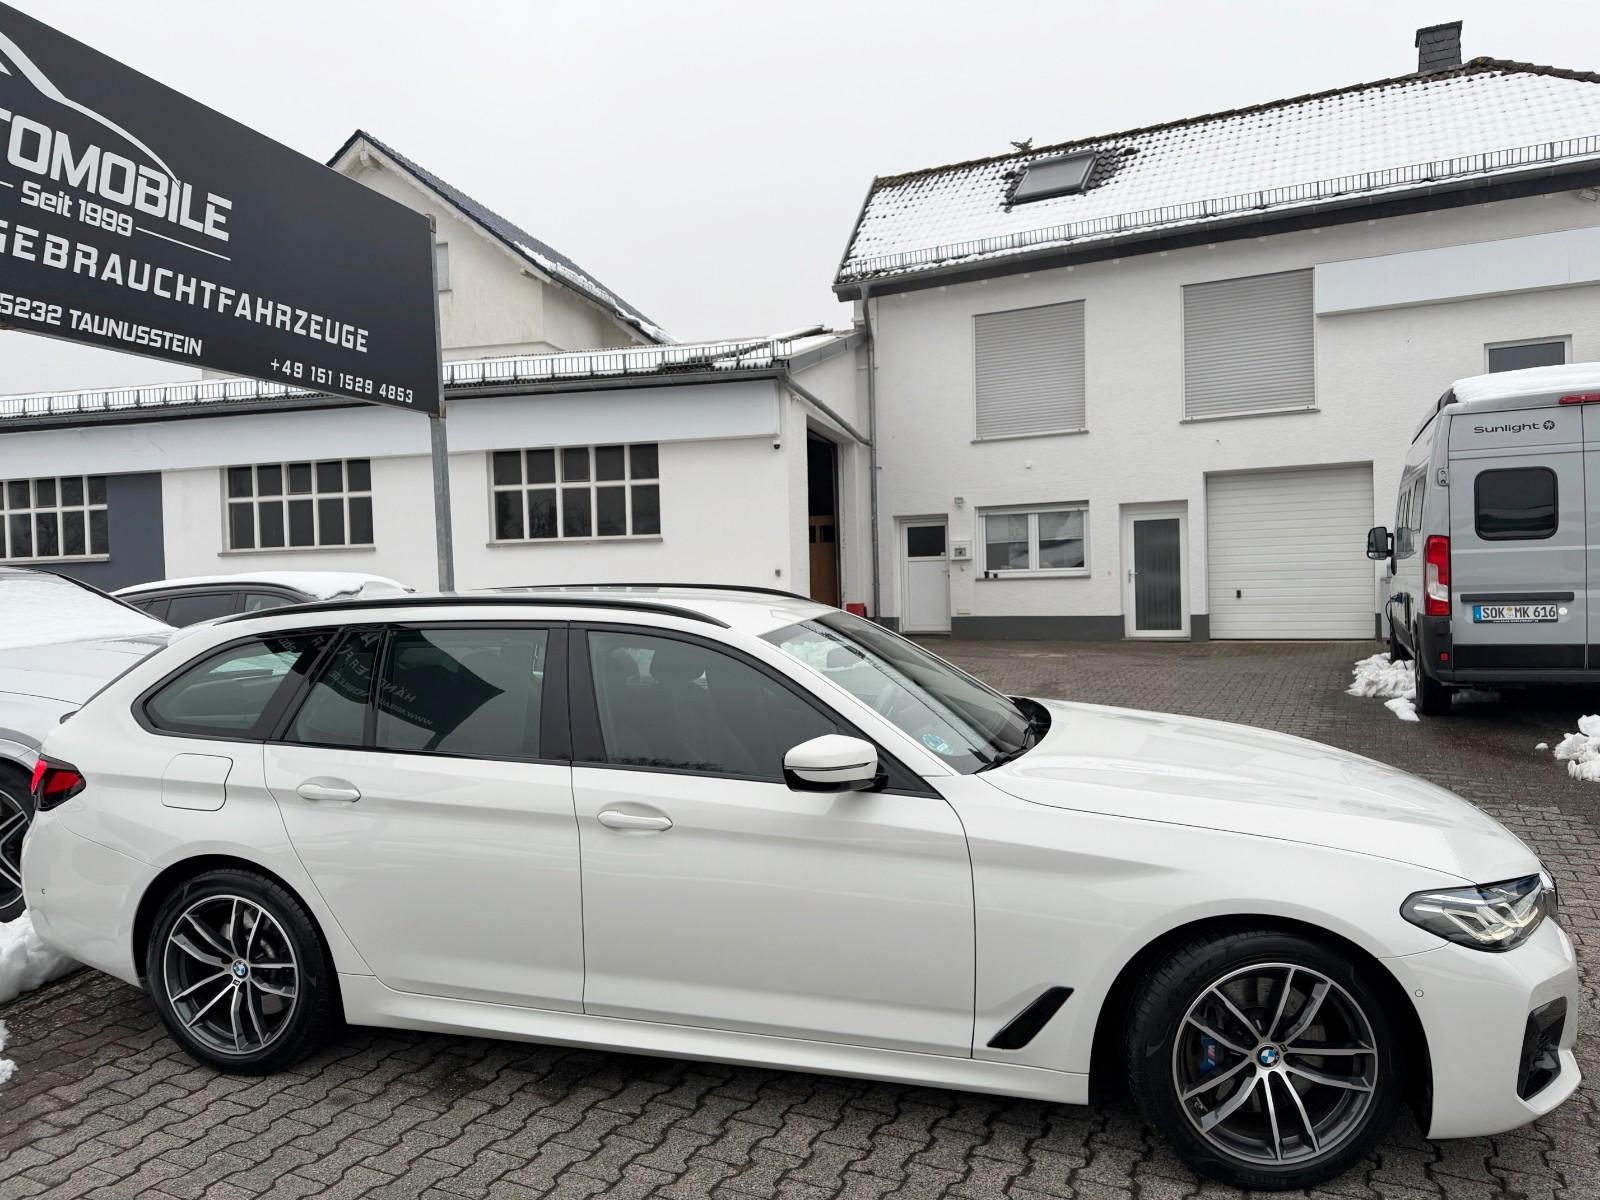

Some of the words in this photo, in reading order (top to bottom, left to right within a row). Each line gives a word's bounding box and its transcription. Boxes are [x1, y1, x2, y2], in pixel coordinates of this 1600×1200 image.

[21, 181, 73, 218] Seit
[79, 199, 133, 237] 1999
[69, 309, 203, 357] TAUNUSSTEIN
[270, 358, 303, 379] +49
[310, 366, 333, 386] 151
[339, 373, 373, 394] 1529
[379, 382, 413, 403] 4853
[1473, 421, 1541, 433] Sunlight
[1482, 607, 1506, 619] SOK
[1514, 606, 1530, 619] MK
[1533, 606, 1555, 618] 616
